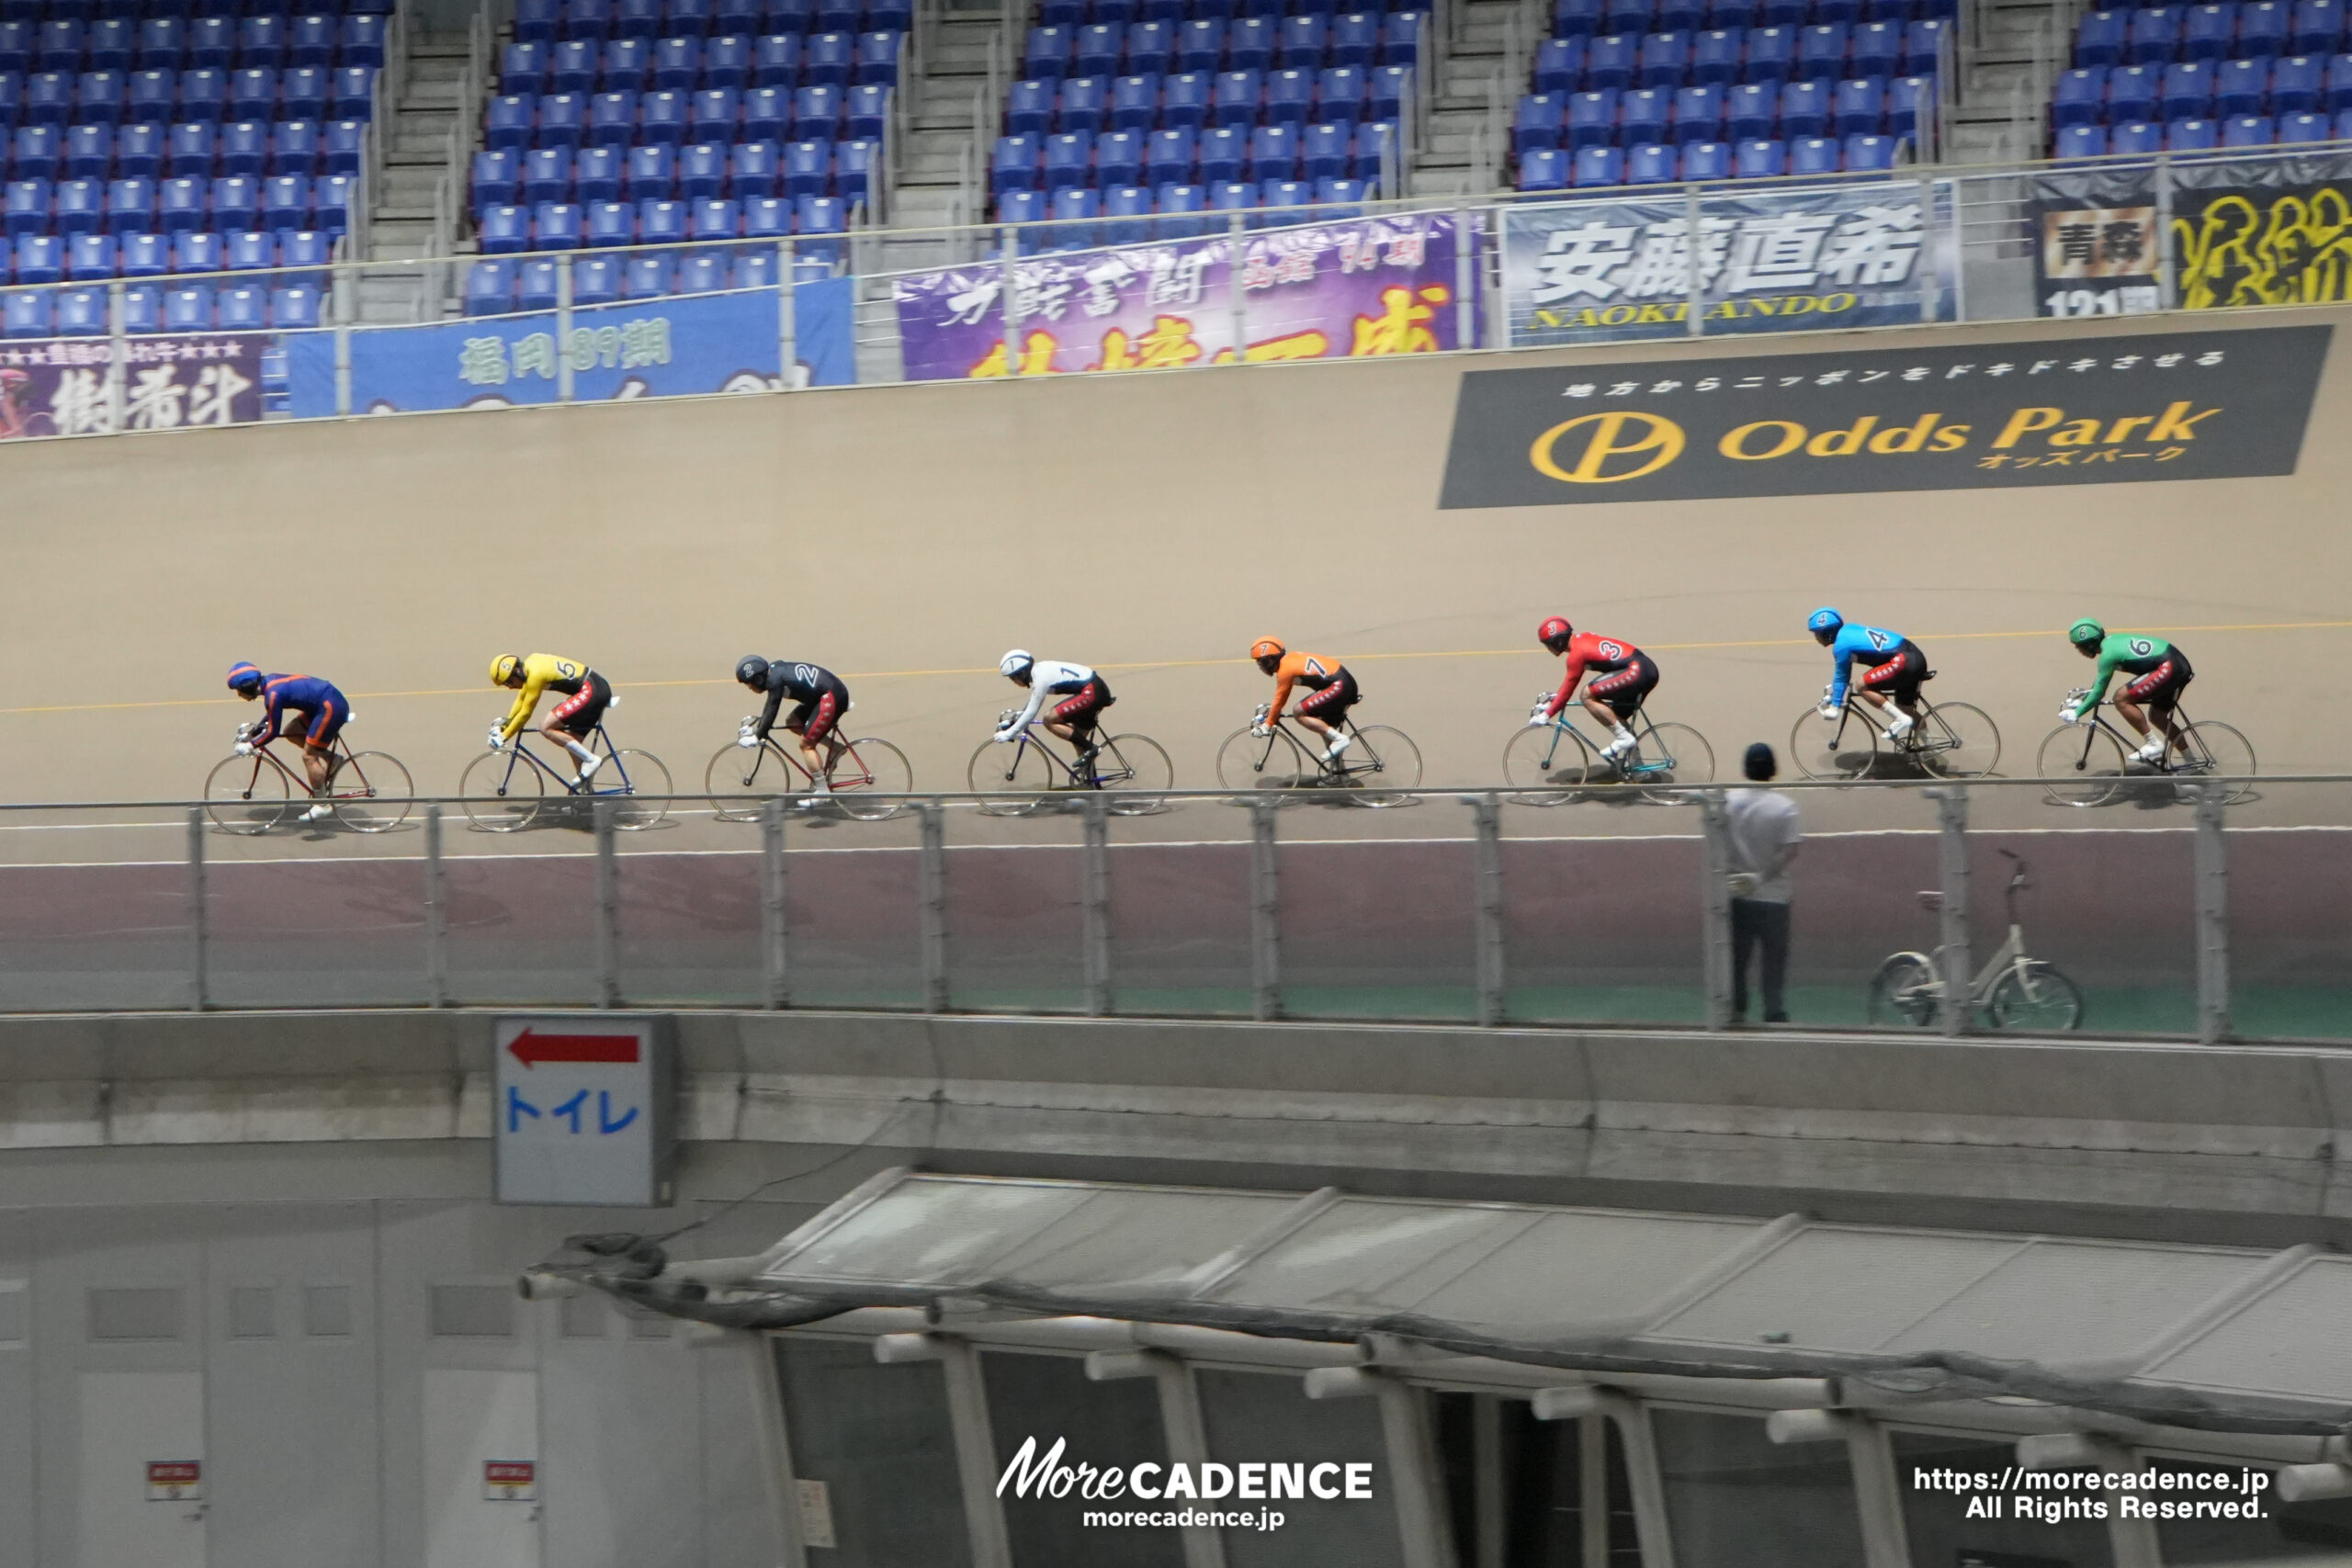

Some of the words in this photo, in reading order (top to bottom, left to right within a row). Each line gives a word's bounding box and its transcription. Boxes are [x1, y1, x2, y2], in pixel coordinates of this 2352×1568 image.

[1532, 204, 1925, 304] 安藤直希
[1705, 293, 1857, 321] ANDO
[1561, 351, 2224, 398] 地方からニッポンをドキドキさせる
[1718, 412, 1973, 460] Odds
[1990, 400, 2225, 449] Park
[1976, 446, 2188, 469] オッズパーク
[1547, 621, 1556, 636] 3
[1817, 612, 1828, 626] 4
[1866, 628, 1889, 651] 4
[2078, 626, 2087, 640] 6
[1260, 644, 1270, 657] 7
[1600, 640, 1622, 660] 3
[2130, 637, 2153, 658] 6
[556, 660, 576, 680] 5
[744, 663, 753, 678] 2
[795, 664, 819, 688] 2
[1060, 667, 1080, 678] 1
[1305, 656, 1326, 678] 7
[508, 1085, 639, 1134] トイレ
